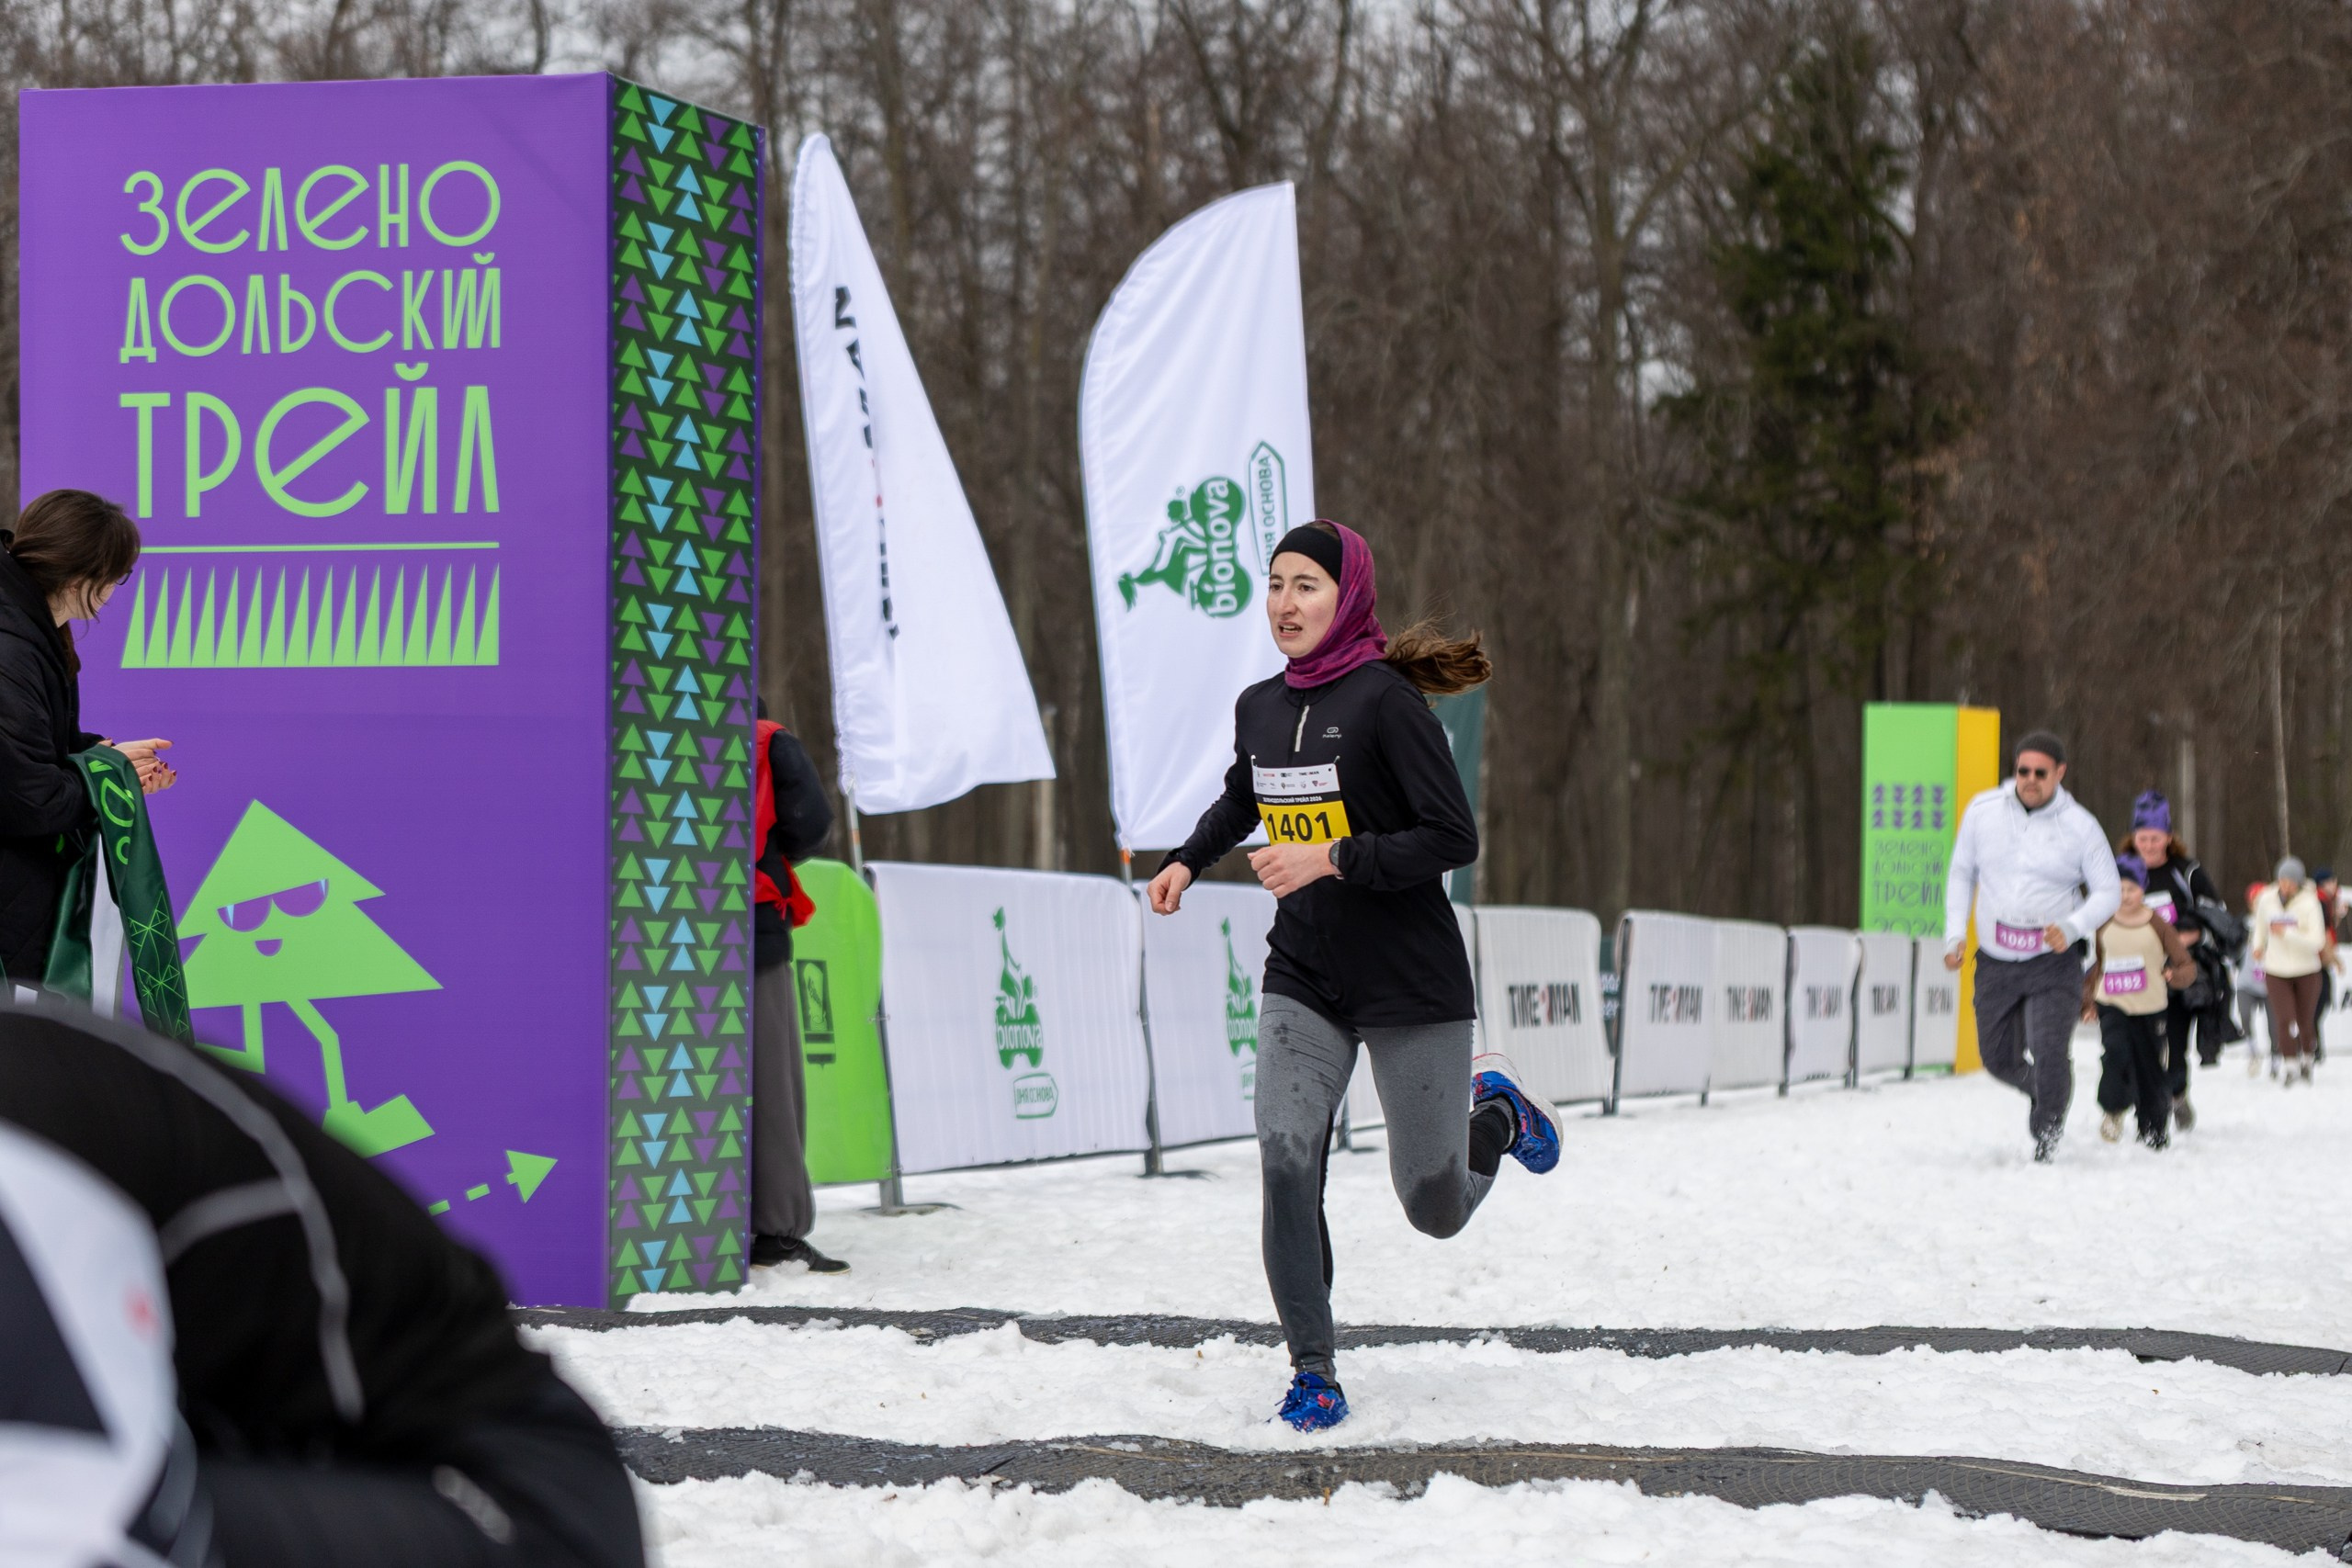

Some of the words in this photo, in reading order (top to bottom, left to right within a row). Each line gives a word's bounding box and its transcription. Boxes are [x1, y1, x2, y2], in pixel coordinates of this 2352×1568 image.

[119, 252, 501, 364] ДОЛЬСКИЙ
[1258, 455, 1276, 528] ОСНОВА
[1202, 479, 1238, 615] bionova
[1267, 811, 1333, 842] 1401
[1999, 931, 2037, 951] 1065
[997, 1015, 1043, 1050] bionova
[1227, 1016, 1257, 1041] bionov
